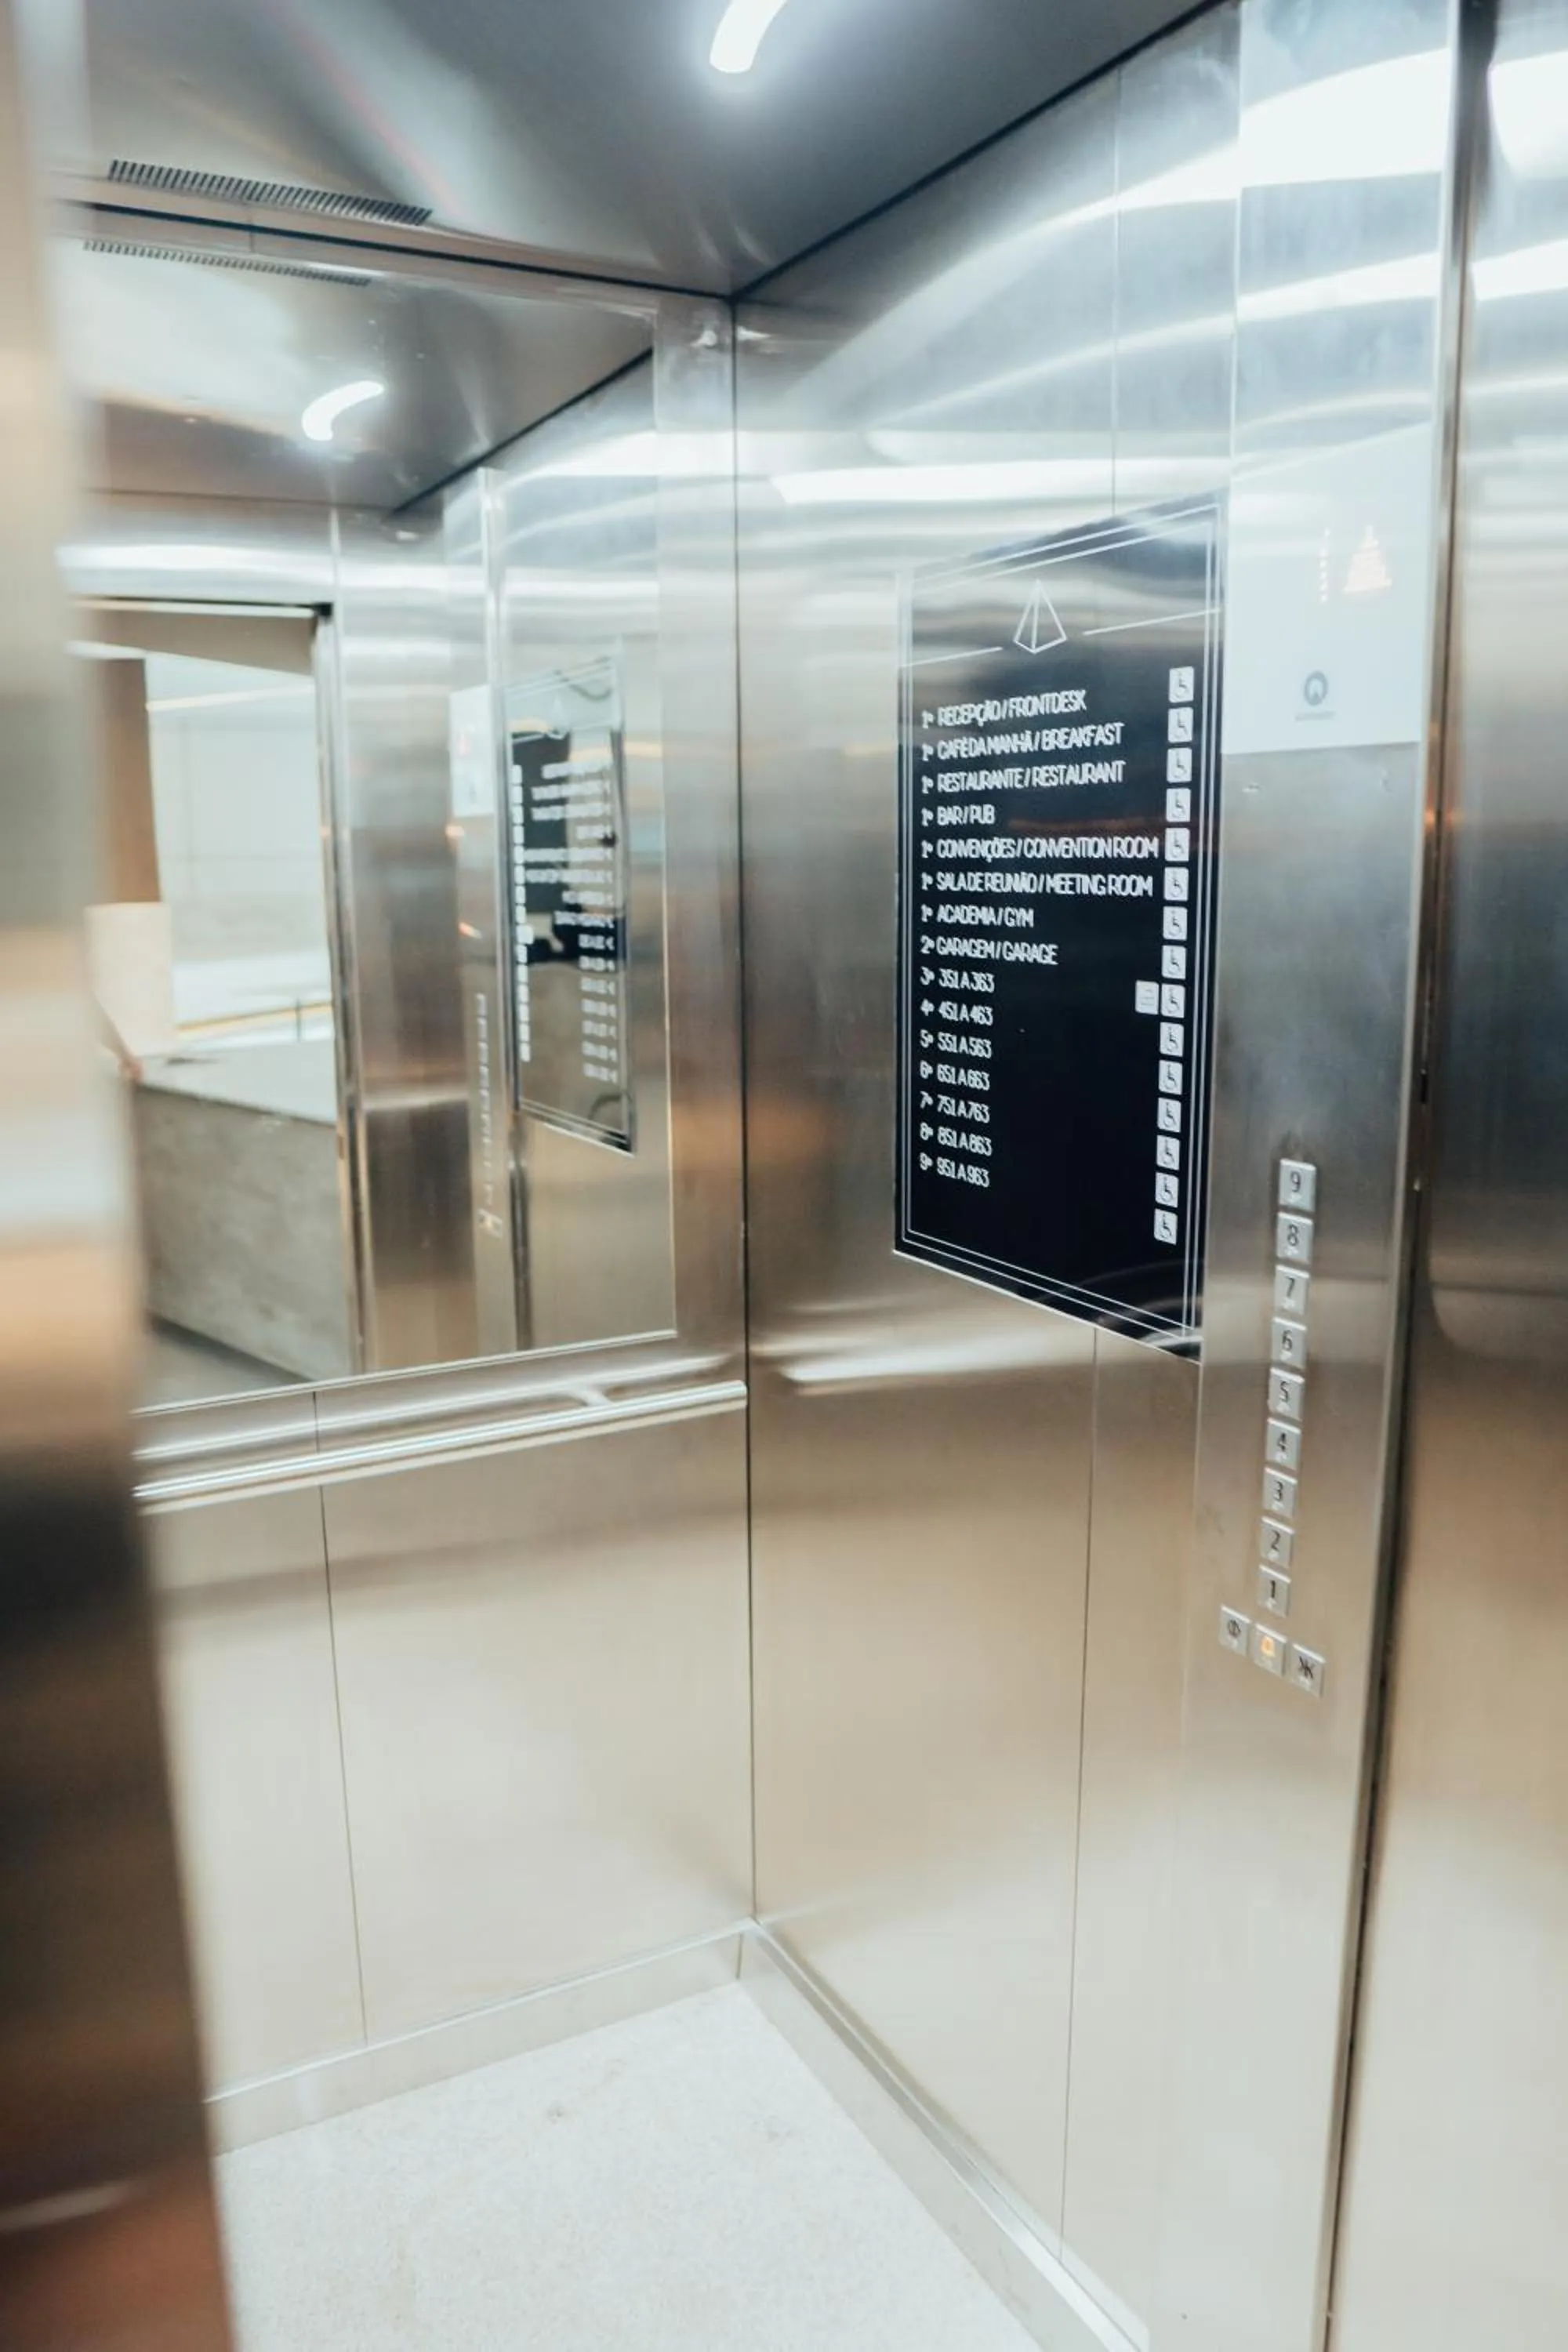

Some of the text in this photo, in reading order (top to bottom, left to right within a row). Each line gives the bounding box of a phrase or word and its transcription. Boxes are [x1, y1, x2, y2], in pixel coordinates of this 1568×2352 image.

[969, 737, 987, 757] DA
[1041, 722, 1124, 751] BREAKFAST
[938, 768, 1024, 793] RESTAURANTE
[1032, 760, 1126, 787] RESTAURANT
[937, 805, 963, 826] BAR
[970, 804, 995, 824] PUB
[1023, 837, 1112, 858] CONVENTION
[1113, 837, 1160, 858] ROOM
[937, 871, 967, 891] SALA
[967, 872, 984, 892] DE
[1046, 873, 1107, 895] MEETING
[1108, 874, 1153, 897] ROOM
[937, 904, 997, 925] ACADEMIA
[1004, 906, 1035, 928] GYM
[936, 936, 995, 960] GARAGEM
[1002, 941, 1058, 965] GARAGE
[938, 967, 960, 989] 351
[960, 971, 971, 990] A
[971, 971, 995, 993] 363
[938, 1000, 958, 1022] 451
[960, 1004, 970, 1022] A
[970, 1005, 993, 1025] 463
[938, 1032, 957, 1053] 551
[959, 1036, 969, 1054] A
[969, 1036, 992, 1058] 563
[937, 1063, 956, 1084] 651
[957, 1068, 967, 1086] A
[967, 1069, 990, 1091] 663
[937, 1094, 956, 1116] 751
[957, 1099, 967, 1119] A
[967, 1101, 989, 1123] 763
[938, 1126, 957, 1148] 851
[959, 1132, 969, 1150] A
[969, 1133, 993, 1156] 863
[937, 1156, 956, 1179] 951
[957, 1163, 967, 1181] A
[967, 1164, 989, 1187] 963
[1290, 1171, 1301, 1192] 9
[1287, 1224, 1299, 1246] 8
[1286, 1276, 1295, 1299] 7
[1281, 1330, 1292, 1351] 6
[1279, 1381, 1289, 1403] 5
[1274, 1480, 1283, 1501] 3
[1271, 1530, 1280, 1552] 2
